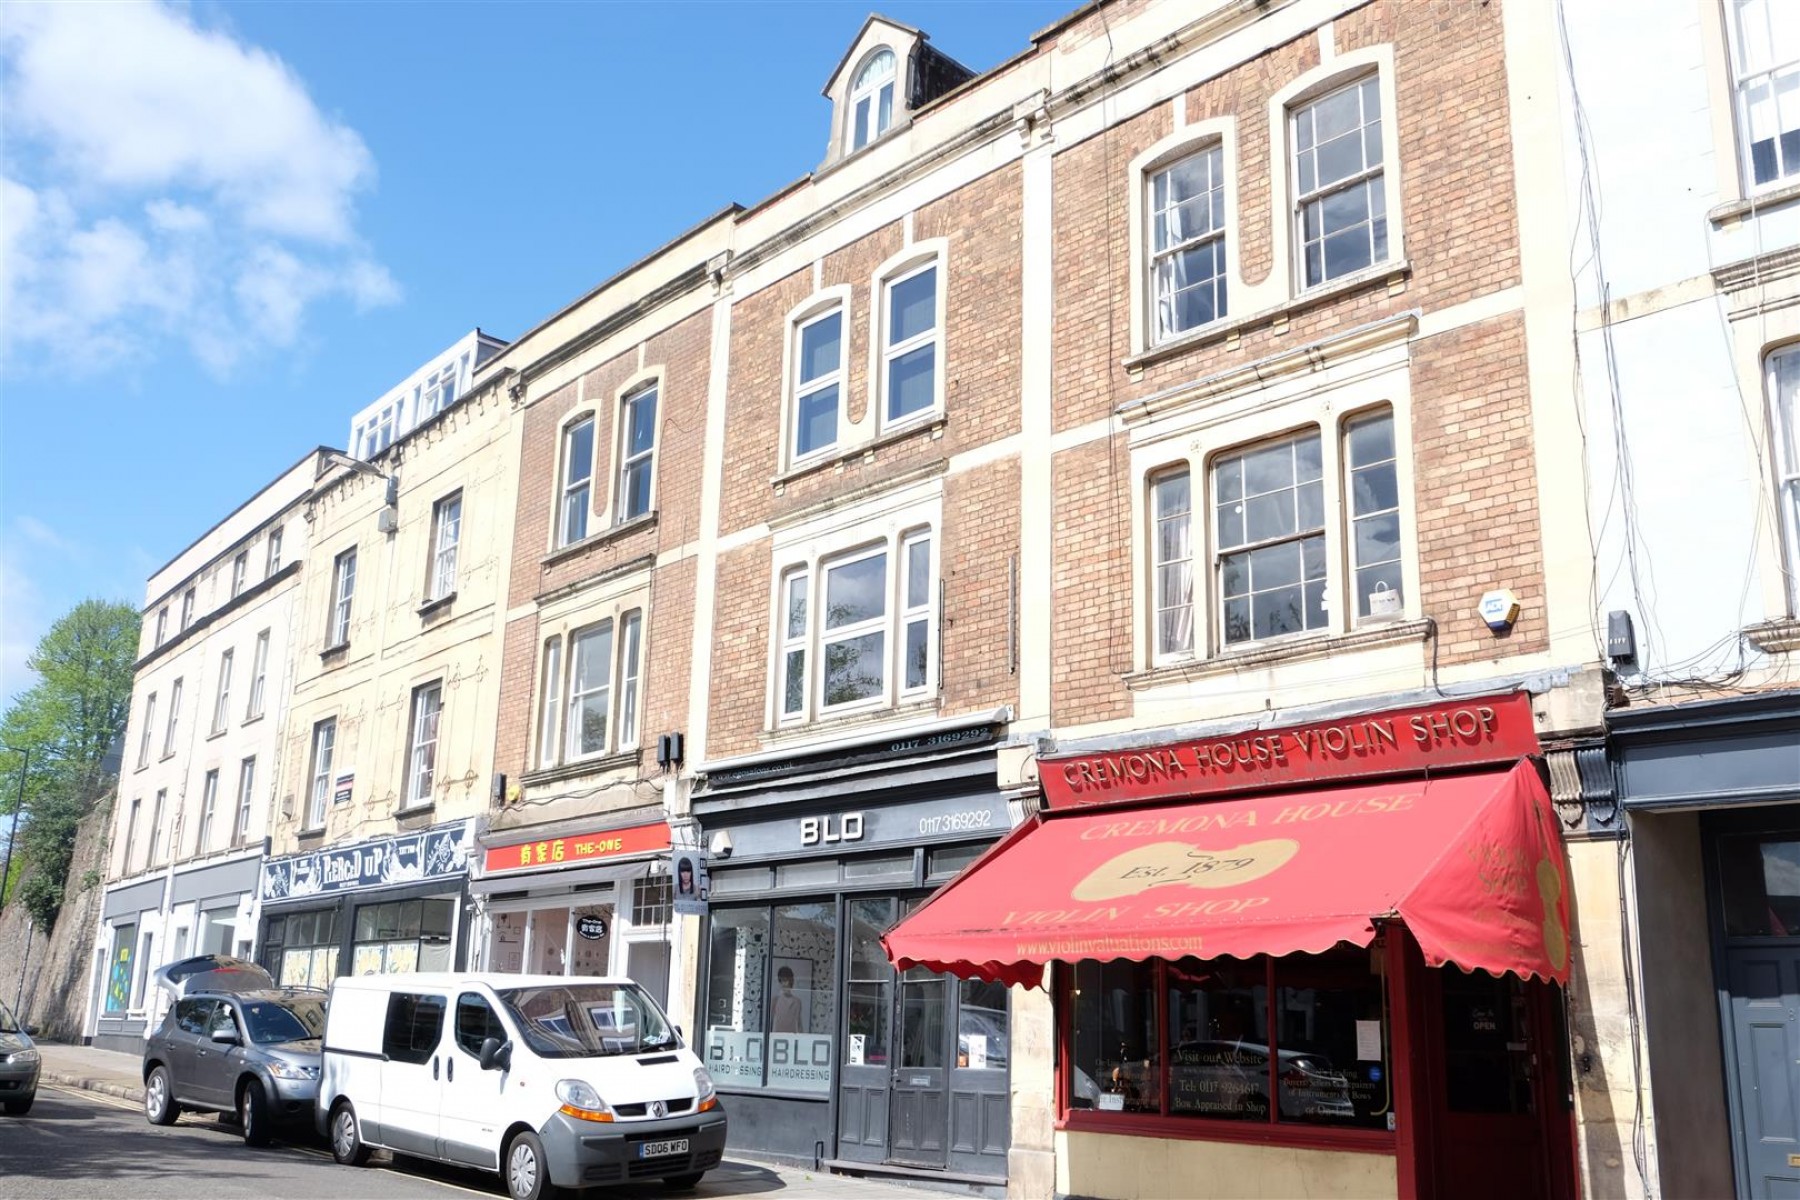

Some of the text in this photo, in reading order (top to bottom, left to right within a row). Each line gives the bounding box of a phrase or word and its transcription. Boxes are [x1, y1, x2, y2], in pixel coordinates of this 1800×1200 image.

[891, 727, 991, 752] 0117 3169292
[1063, 749, 1186, 786] CREMONA
[1192, 734, 1287, 770] HOUSE
[1291, 719, 1397, 754] VIOLIN
[1408, 706, 1495, 742] SHOP
[800, 811, 864, 844] BLO
[1079, 793, 1419, 841] CREMONA HOUSE
[574, 838, 622, 856] THE-ONE
[1120, 857, 1256, 880] Est. 1879
[1001, 898, 1270, 925] VIOLIN SHOP
[1016, 933, 1204, 956] www.violinvaluations.com
[772, 1039, 831, 1067] BLO
[708, 1063, 763, 1077] HAIRDSSING
[771, 1067, 831, 1081] HAIRDRESSING
[645, 1142, 669, 1156] SD06
